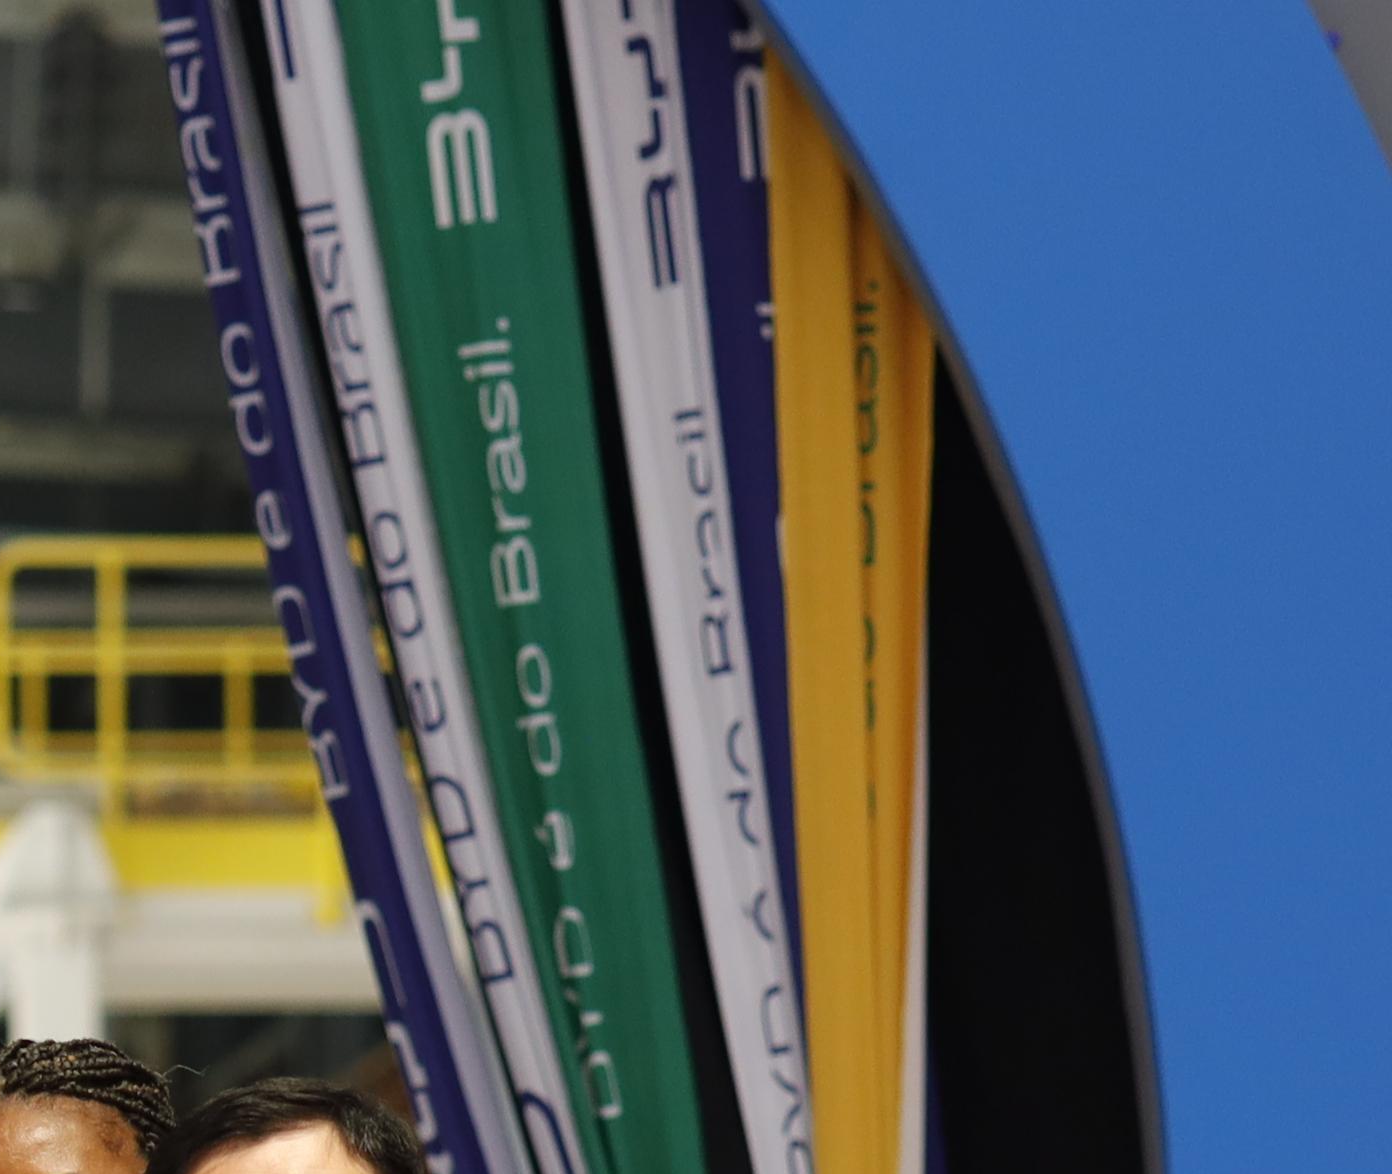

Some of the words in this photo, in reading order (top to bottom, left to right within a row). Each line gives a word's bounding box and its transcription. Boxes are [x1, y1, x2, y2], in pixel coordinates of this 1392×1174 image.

[420, 0, 498, 229] BY
[458, 317, 540, 607] Brasil.
[516, 643, 563, 776] do
